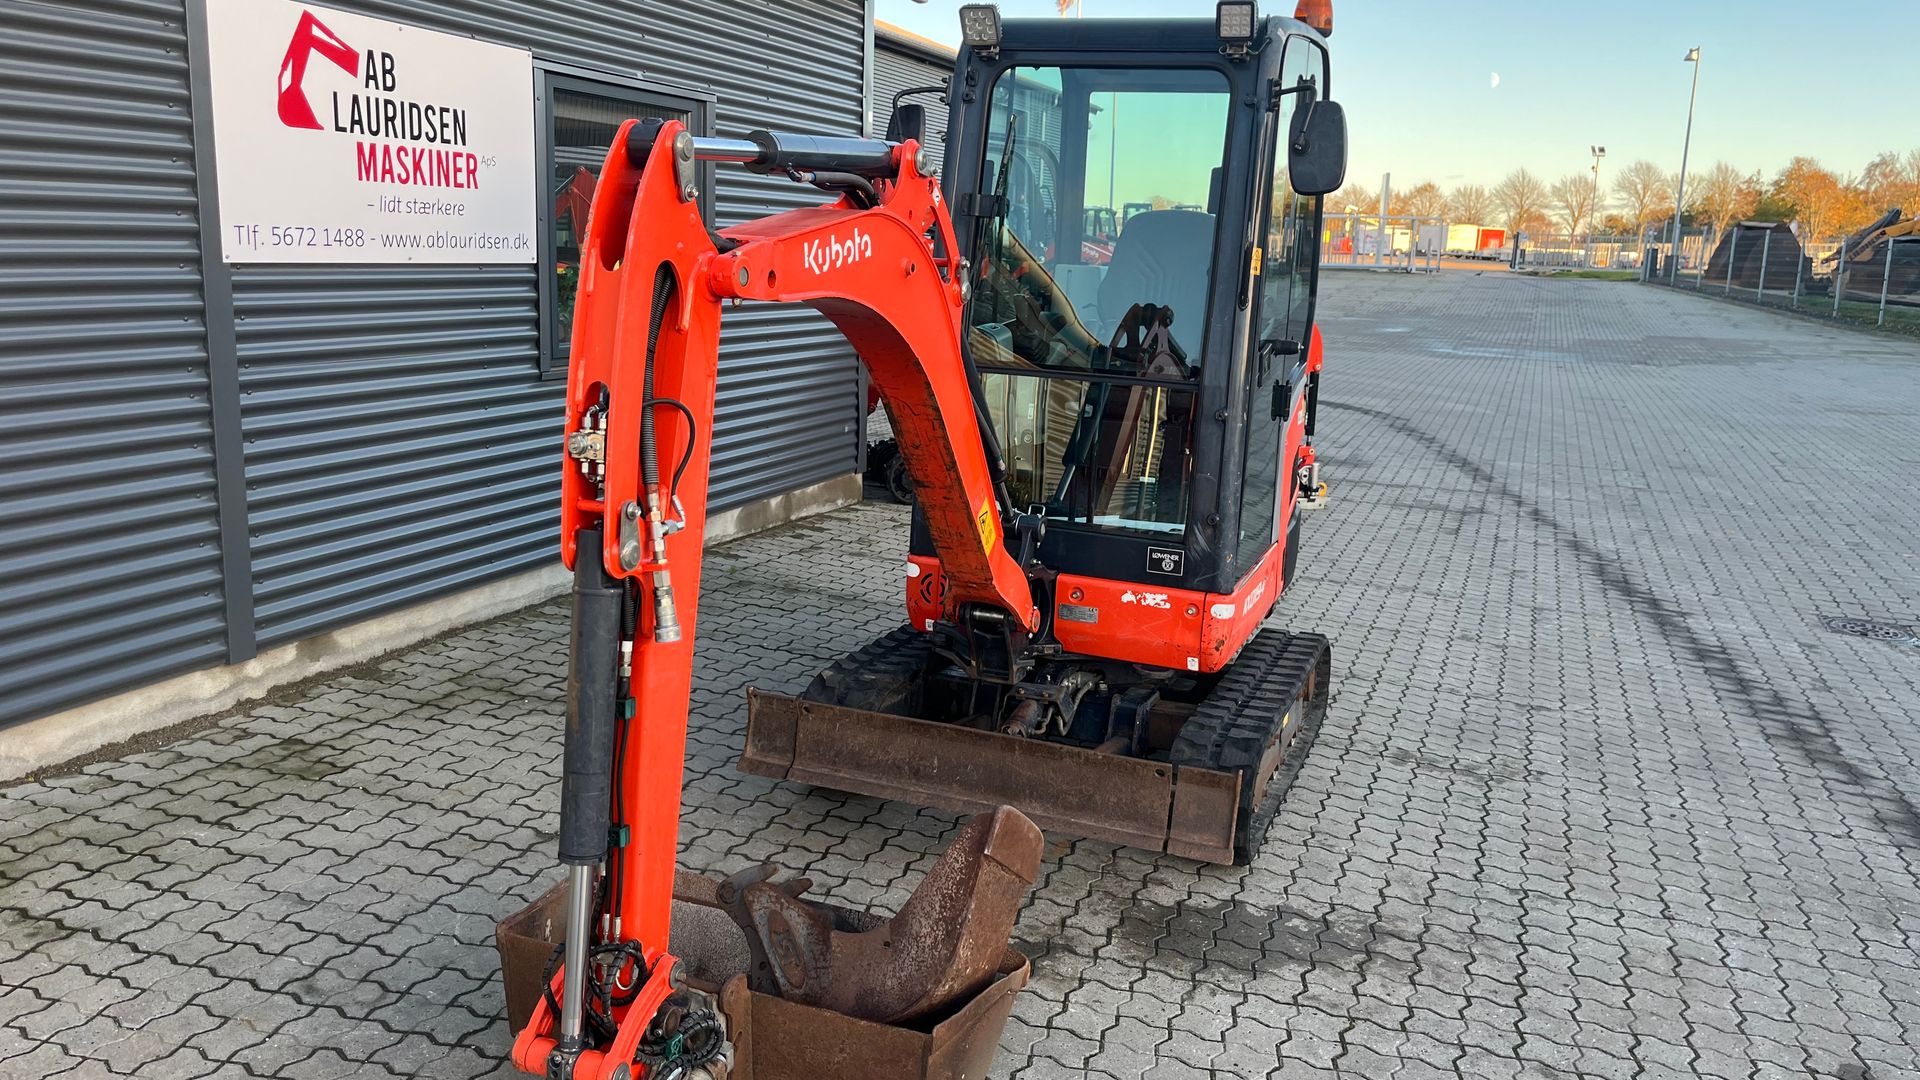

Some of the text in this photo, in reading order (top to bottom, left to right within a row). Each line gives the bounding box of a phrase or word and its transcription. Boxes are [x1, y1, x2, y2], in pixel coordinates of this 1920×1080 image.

[365, 50, 396, 91] AB
[333, 91, 467, 146] LAURIDSEN
[357, 141, 479, 189] MASKINER
[480, 154, 497, 168] ApS
[379, 195, 402, 214] lidt
[406, 200, 465, 216] stærkere
[233, 224, 266, 251] Tlf.
[272, 226, 317, 247] 5672
[323, 228, 366, 248] 1488
[380, 233, 530, 250] www.ablauridsen.dk
[804, 227, 872, 275] Kubota
